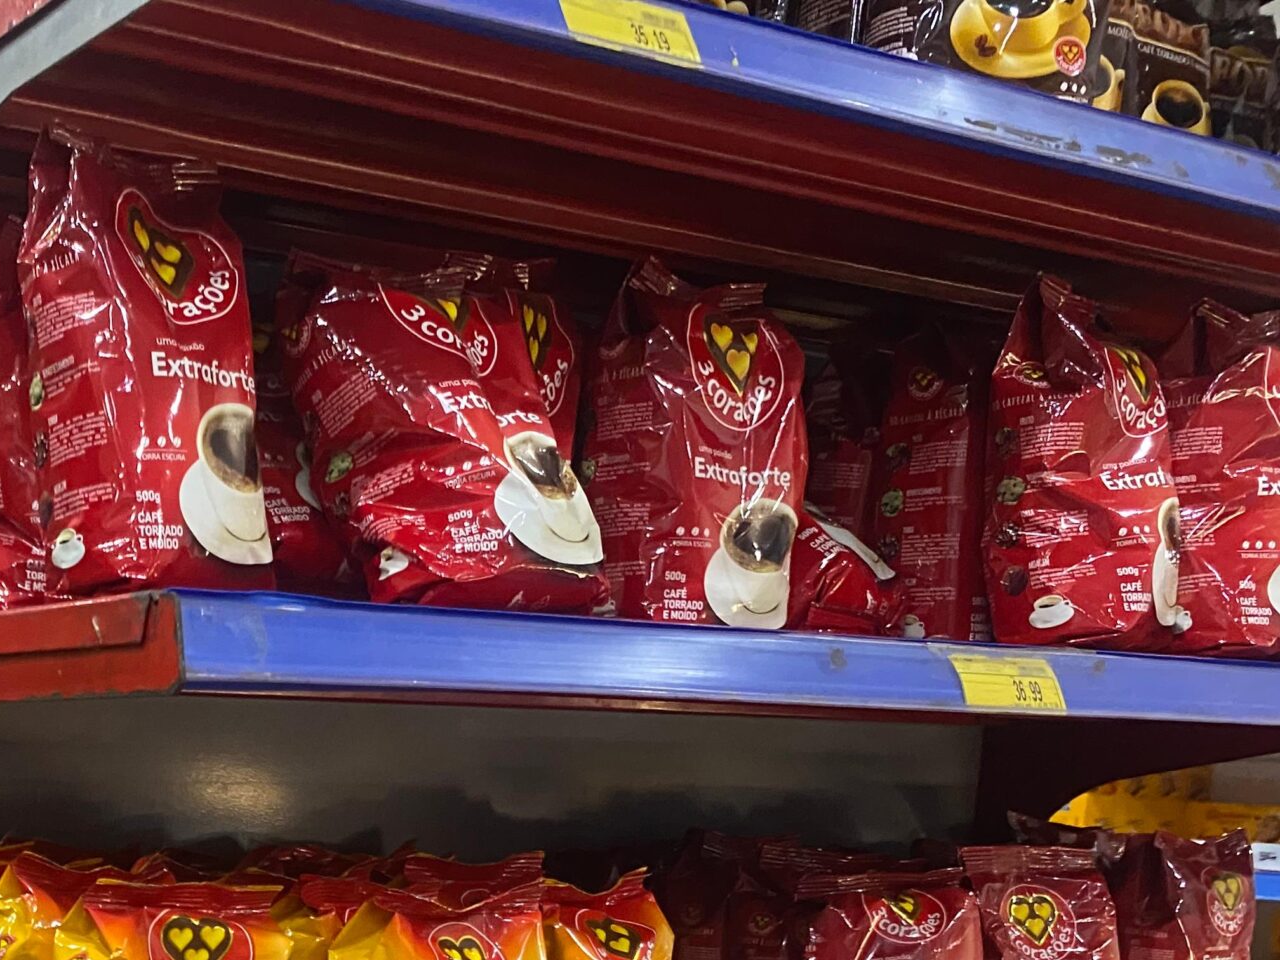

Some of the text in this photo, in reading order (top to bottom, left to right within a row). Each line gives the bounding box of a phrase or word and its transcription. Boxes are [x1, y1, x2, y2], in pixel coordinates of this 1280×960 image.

[631, 23, 671, 51] 35.19
[401, 304, 426, 322] 3
[151, 351, 256, 395] Extraforte
[698, 360, 715, 376] 3
[1120, 383, 1166, 430] coraçõ
[694, 456, 791, 488] Extraforte
[136, 490, 160, 503] 500g
[140, 525, 183, 539] TORRADO
[140, 537, 147, 549] E
[665, 571, 686, 582] 500g
[1117, 566, 1139, 577] 500g
[664, 586, 687, 598] CAFÉ
[1120, 580, 1143, 592] CAFÉ
[664, 600, 704, 611] TORRADO
[1240, 596, 1257, 607] CAFÉ
[663, 610, 669, 620] E
[1013, 680, 1043, 702] 36.99
